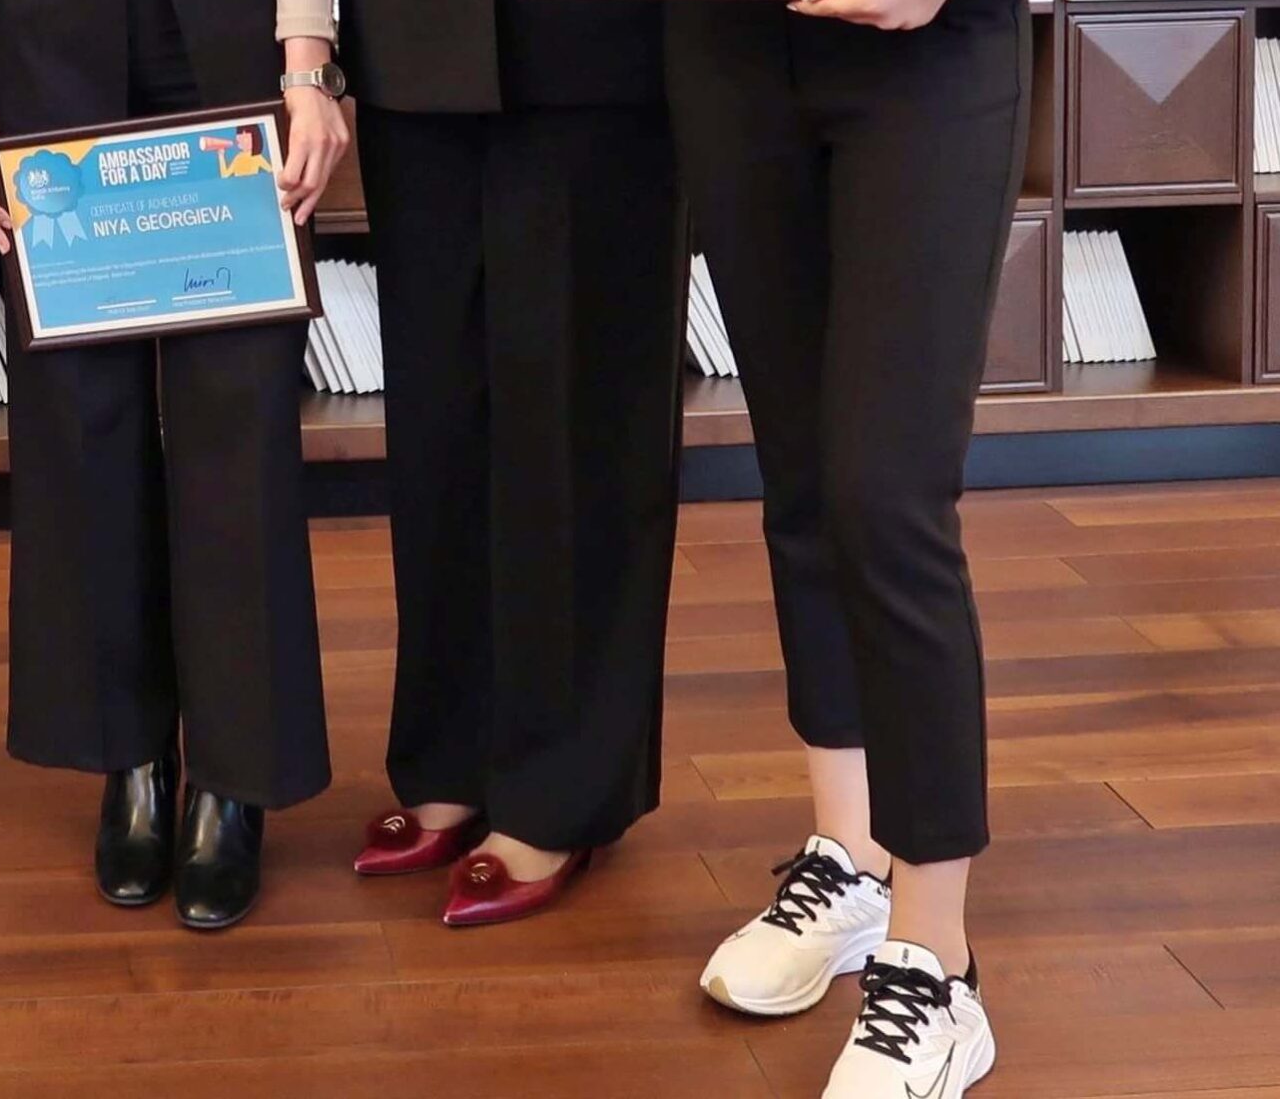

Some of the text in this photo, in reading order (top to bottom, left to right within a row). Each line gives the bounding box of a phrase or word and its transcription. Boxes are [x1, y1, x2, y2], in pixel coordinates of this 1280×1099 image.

[98, 141, 190, 171] AMBASSADOR
[101, 162, 168, 186] FOR A DAY
[90, 192, 199, 217] CERTIFICATE OF ACHIEVEMENT
[93, 205, 233, 238] NIYA GEORGIEVA
